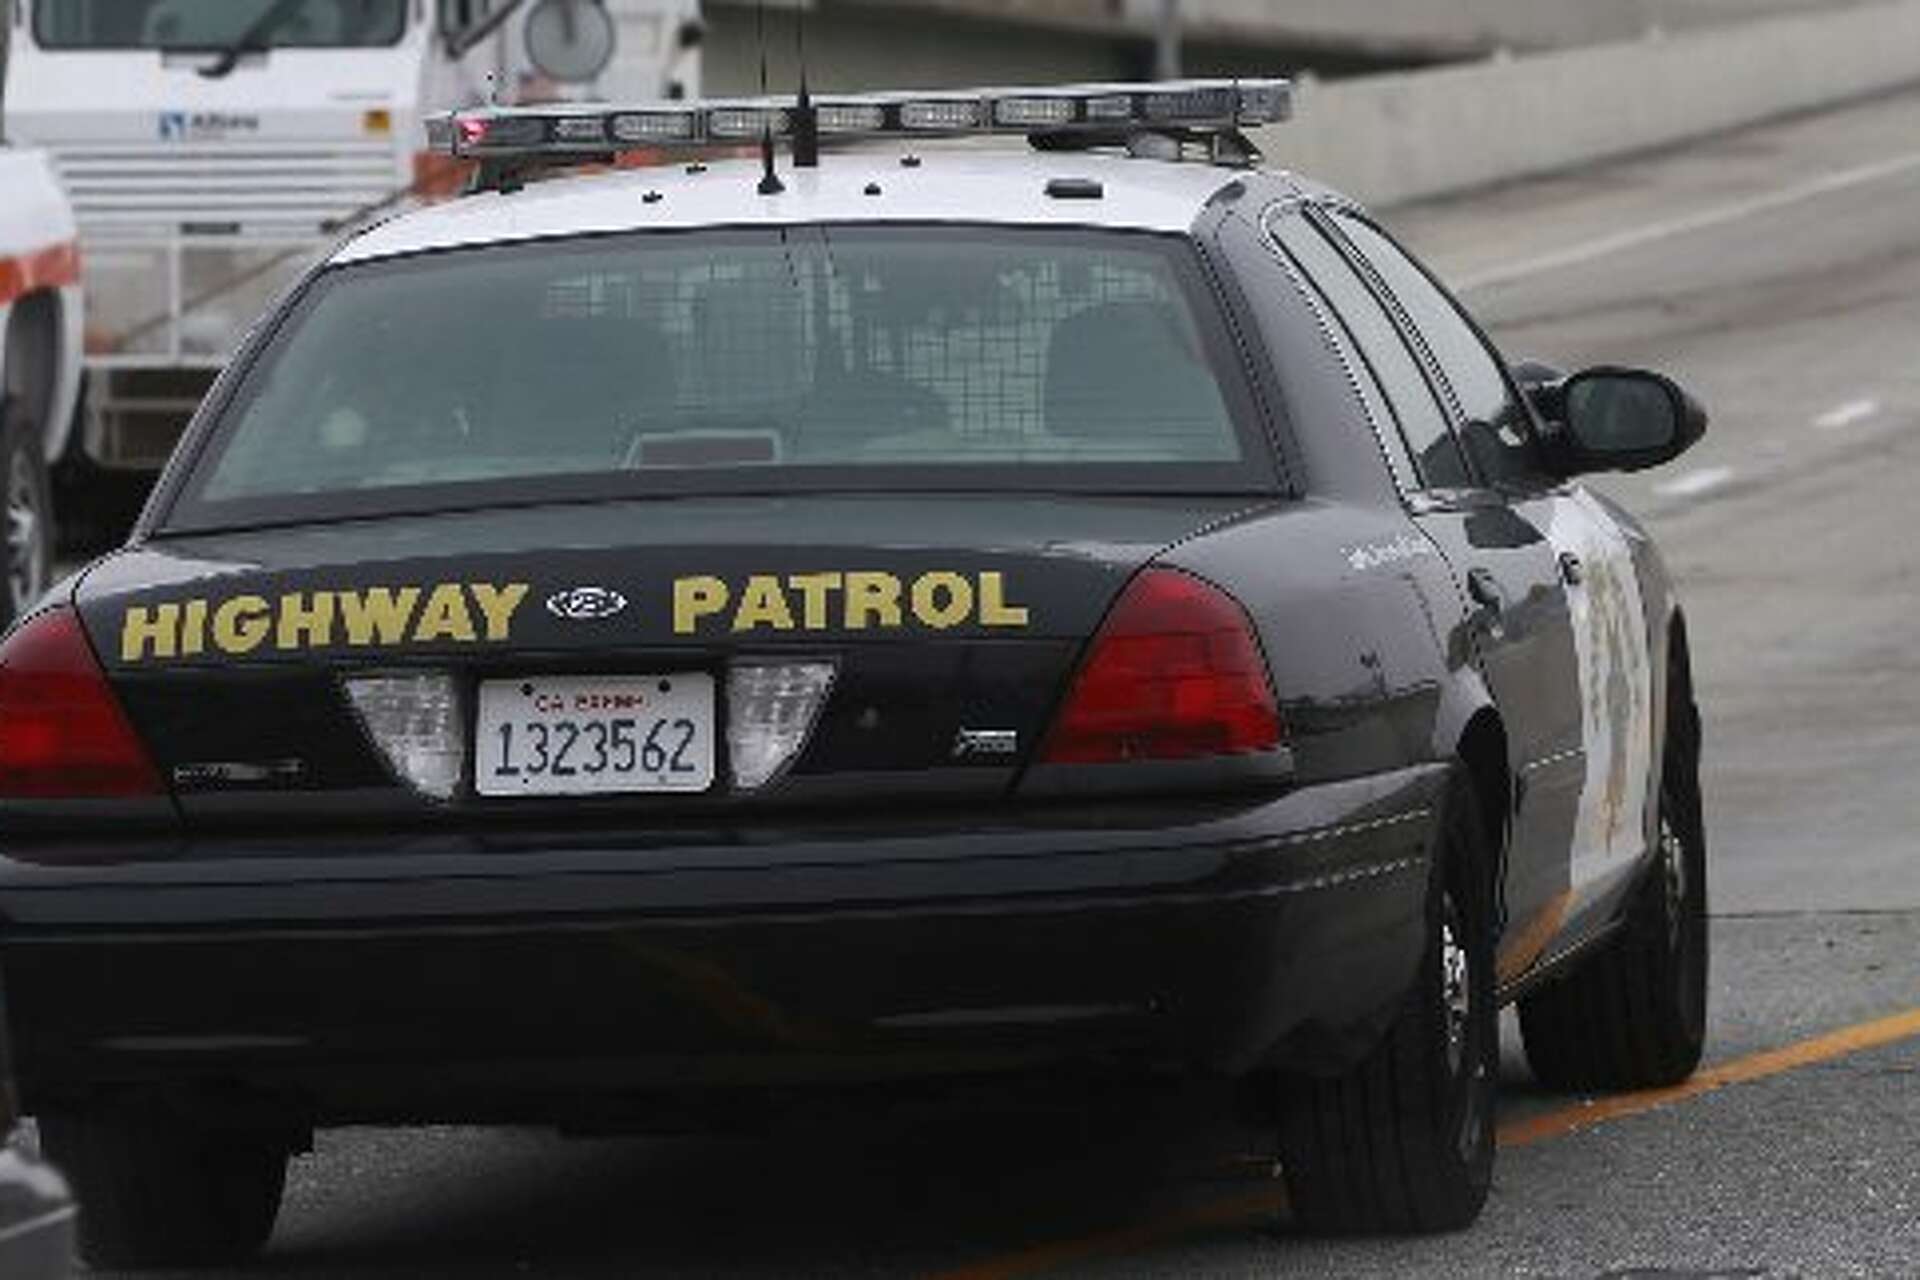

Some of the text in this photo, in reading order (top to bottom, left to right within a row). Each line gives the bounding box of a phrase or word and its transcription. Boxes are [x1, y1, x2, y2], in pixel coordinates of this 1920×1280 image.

[121, 583, 529, 661] HIGHWAY
[673, 571, 1029, 633] PATROL
[495, 718, 696, 776] 1323562
